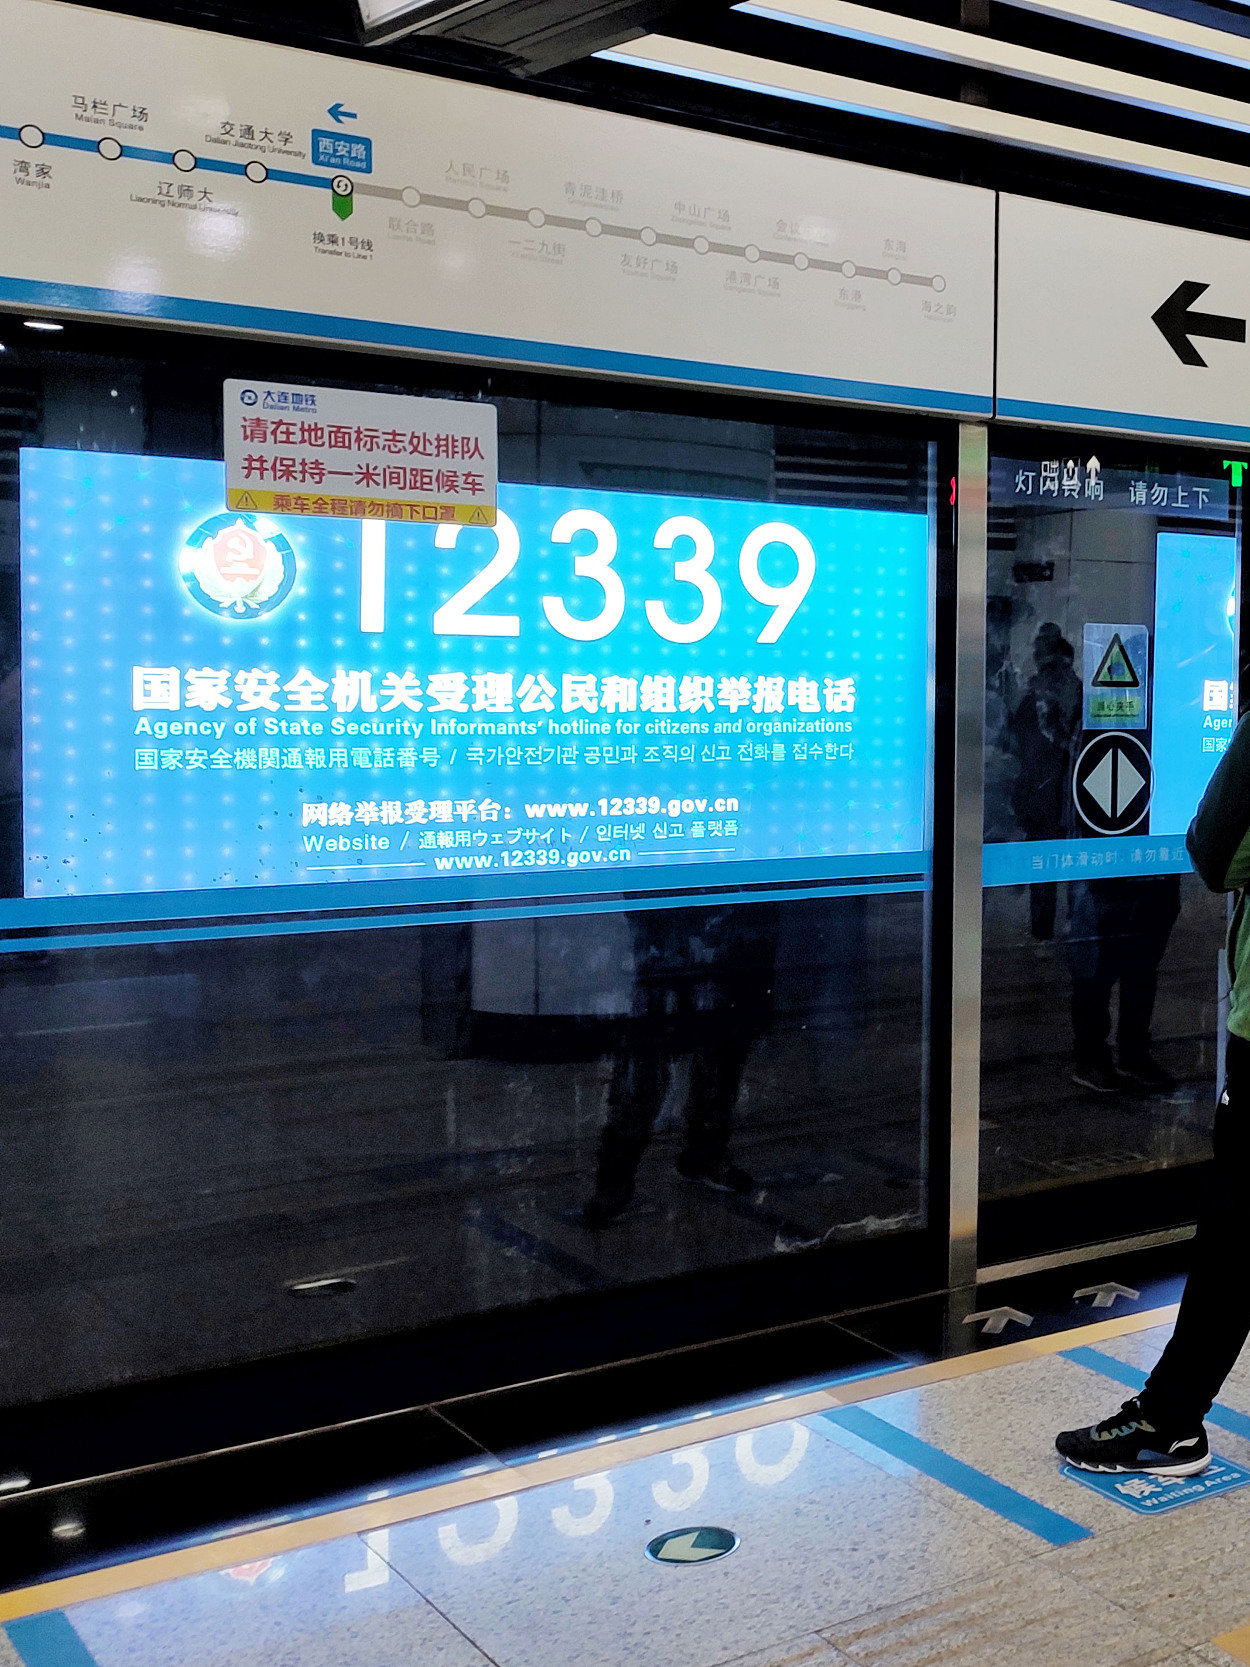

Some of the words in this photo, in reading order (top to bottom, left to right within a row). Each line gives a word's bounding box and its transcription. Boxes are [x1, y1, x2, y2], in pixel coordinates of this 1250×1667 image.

[72, 95, 148, 122] 马栏广场
[75, 113, 106, 126] Malan
[108, 116, 144, 131] Square
[205, 134, 230, 146] Dalian
[220, 121, 293, 146] 交通大学
[317, 136, 366, 159] 西安路
[13, 160, 53, 180] 湾家
[343, 156, 366, 169] Road
[444, 159, 510, 183] 人民广场
[15, 176, 50, 190] Wanjia
[157, 181, 214, 203] 辽师大
[674, 202, 730, 222] 中山广场
[388, 216, 435, 237] 联合路
[313, 231, 374, 252] 换乘1号线
[620, 253, 678, 275] 友好广场
[262, 389, 317, 407] 大连地铁
[262, 402, 290, 412] Dalian
[292, 404, 317, 414] Metro
[240, 417, 485, 461] 请在地面标志处排队
[241, 454, 485, 496] 并保持一米间距候车
[1129, 480, 1211, 509] 请勿上下
[273, 494, 456, 522] 乘车全程请勿摘下口罩
[358, 508, 817, 645] 12339
[132, 666, 857, 713] 国家安全机关受理公民和组织举报电话
[134, 717, 226, 739] Agency
[234, 717, 257, 735] of
[264, 717, 323, 736] State
[331, 717, 424, 739] Security
[548, 718, 611, 735] hotline
[616, 718, 640, 735] for
[645, 717, 709, 735] citizens
[714, 718, 742, 734] and
[746, 718, 853, 736] organizations
[135, 748, 441, 771] 国家安全機関通報用電話番号
[466, 745, 579, 766] 국가안전기관
[584, 744, 638, 764] 공민과
[643, 743, 695, 764] 조직의
[701, 743, 732, 762] 신고
[737, 742, 787, 762] 전화를
[793, 742, 854, 761] 접수한다
[525, 796, 739, 818] www.12339.gov.cn
[303, 833, 390, 852] Website
[418, 827, 572, 850] 通報用ウェブサイト
[596, 822, 646, 842] 인터넷
[653, 821, 685, 839] 신고
[691, 819, 739, 838] 플랫폼
[435, 847, 631, 870] www.12339.gov.cn
[1141, 1483, 1206, 1507] Waiting
[1205, 1471, 1242, 1488] Area
